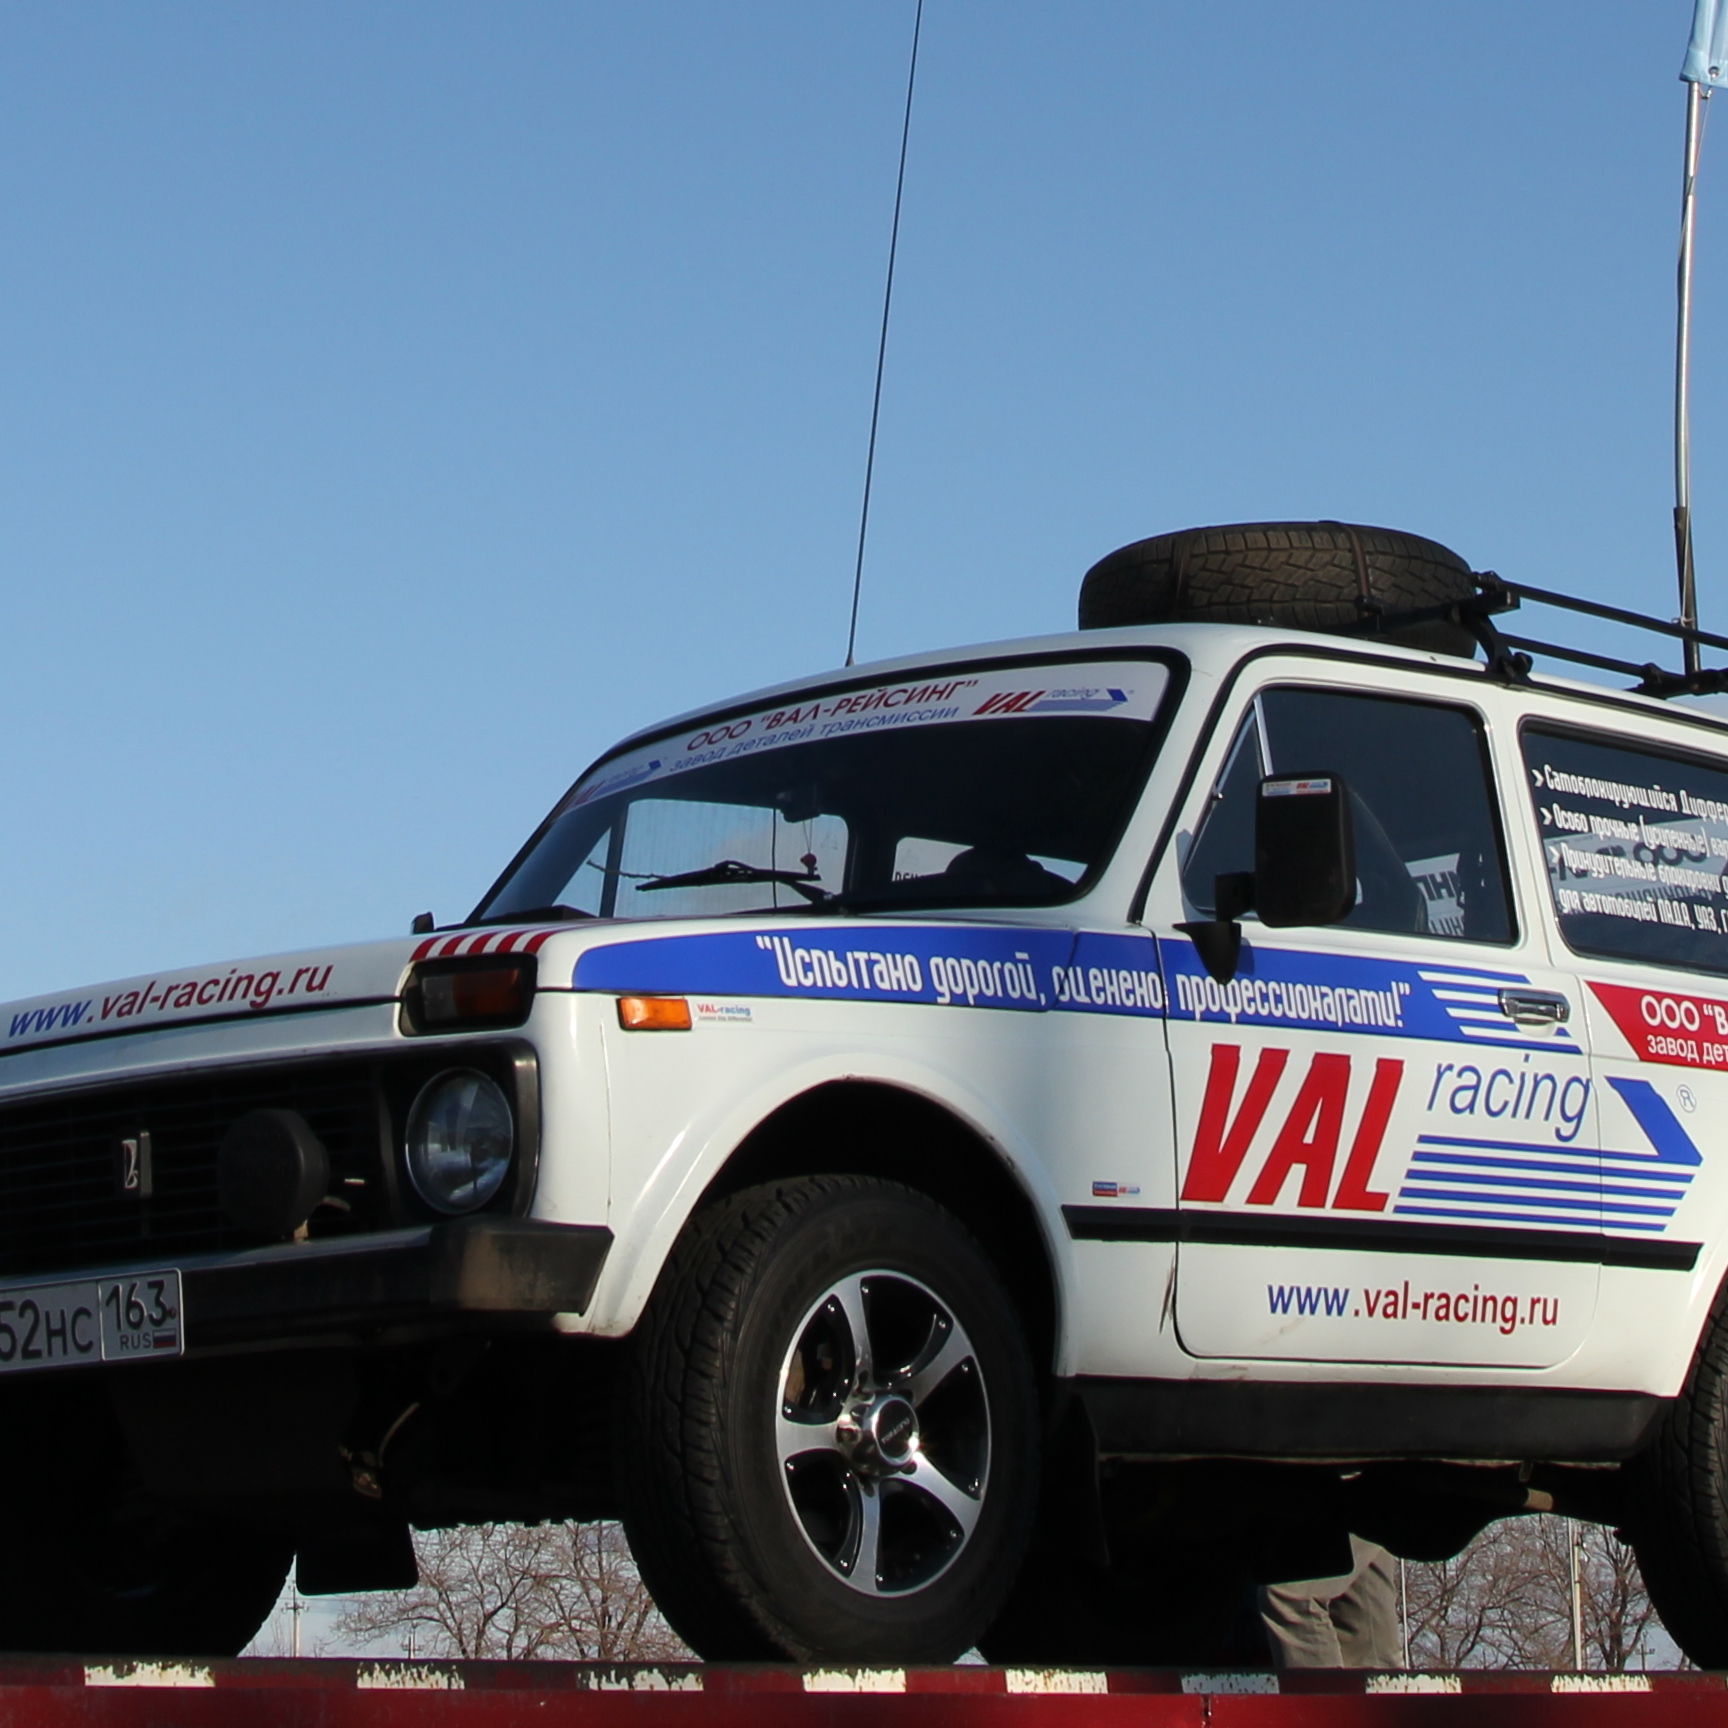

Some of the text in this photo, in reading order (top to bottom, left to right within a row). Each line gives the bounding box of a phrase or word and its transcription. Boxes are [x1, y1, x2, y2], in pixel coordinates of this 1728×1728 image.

[972, 690, 1047, 716] VAL
[669, 748, 725, 772] завод
[726, 727, 814, 758] деталей
[819, 706, 960, 737] трансмиссии
[687, 719, 753, 751] ООО
[1544, 764, 1678, 812] Самоблокирующийся
[1553, 803, 1589, 833] Особо
[1589, 815, 1640, 841] прочные
[1561, 842, 1657, 881] Принудительные
[1658, 864, 1721, 893] блокировки
[1558, 888, 1582, 913] для
[1581, 891, 1658, 922] автомобилей
[1657, 897, 1695, 930] ЛАДА,
[1694, 904, 1721, 934] УАЗ,
[8, 964, 334, 1038] www.val-racing.ru
[929, 951, 1047, 1006] дорогой,
[1052, 964, 1168, 1014] оценено
[1641, 994, 1700, 1032] ООО
[1647, 1034, 1699, 1063] завод
[1179, 1043, 1405, 1213] VAL
[1426, 1053, 1592, 1143] racing
[105, 1279, 168, 1331] 163
[1267, 1280, 1559, 1335] www.val-racing.ru
[120, 1332, 152, 1351] RUS
